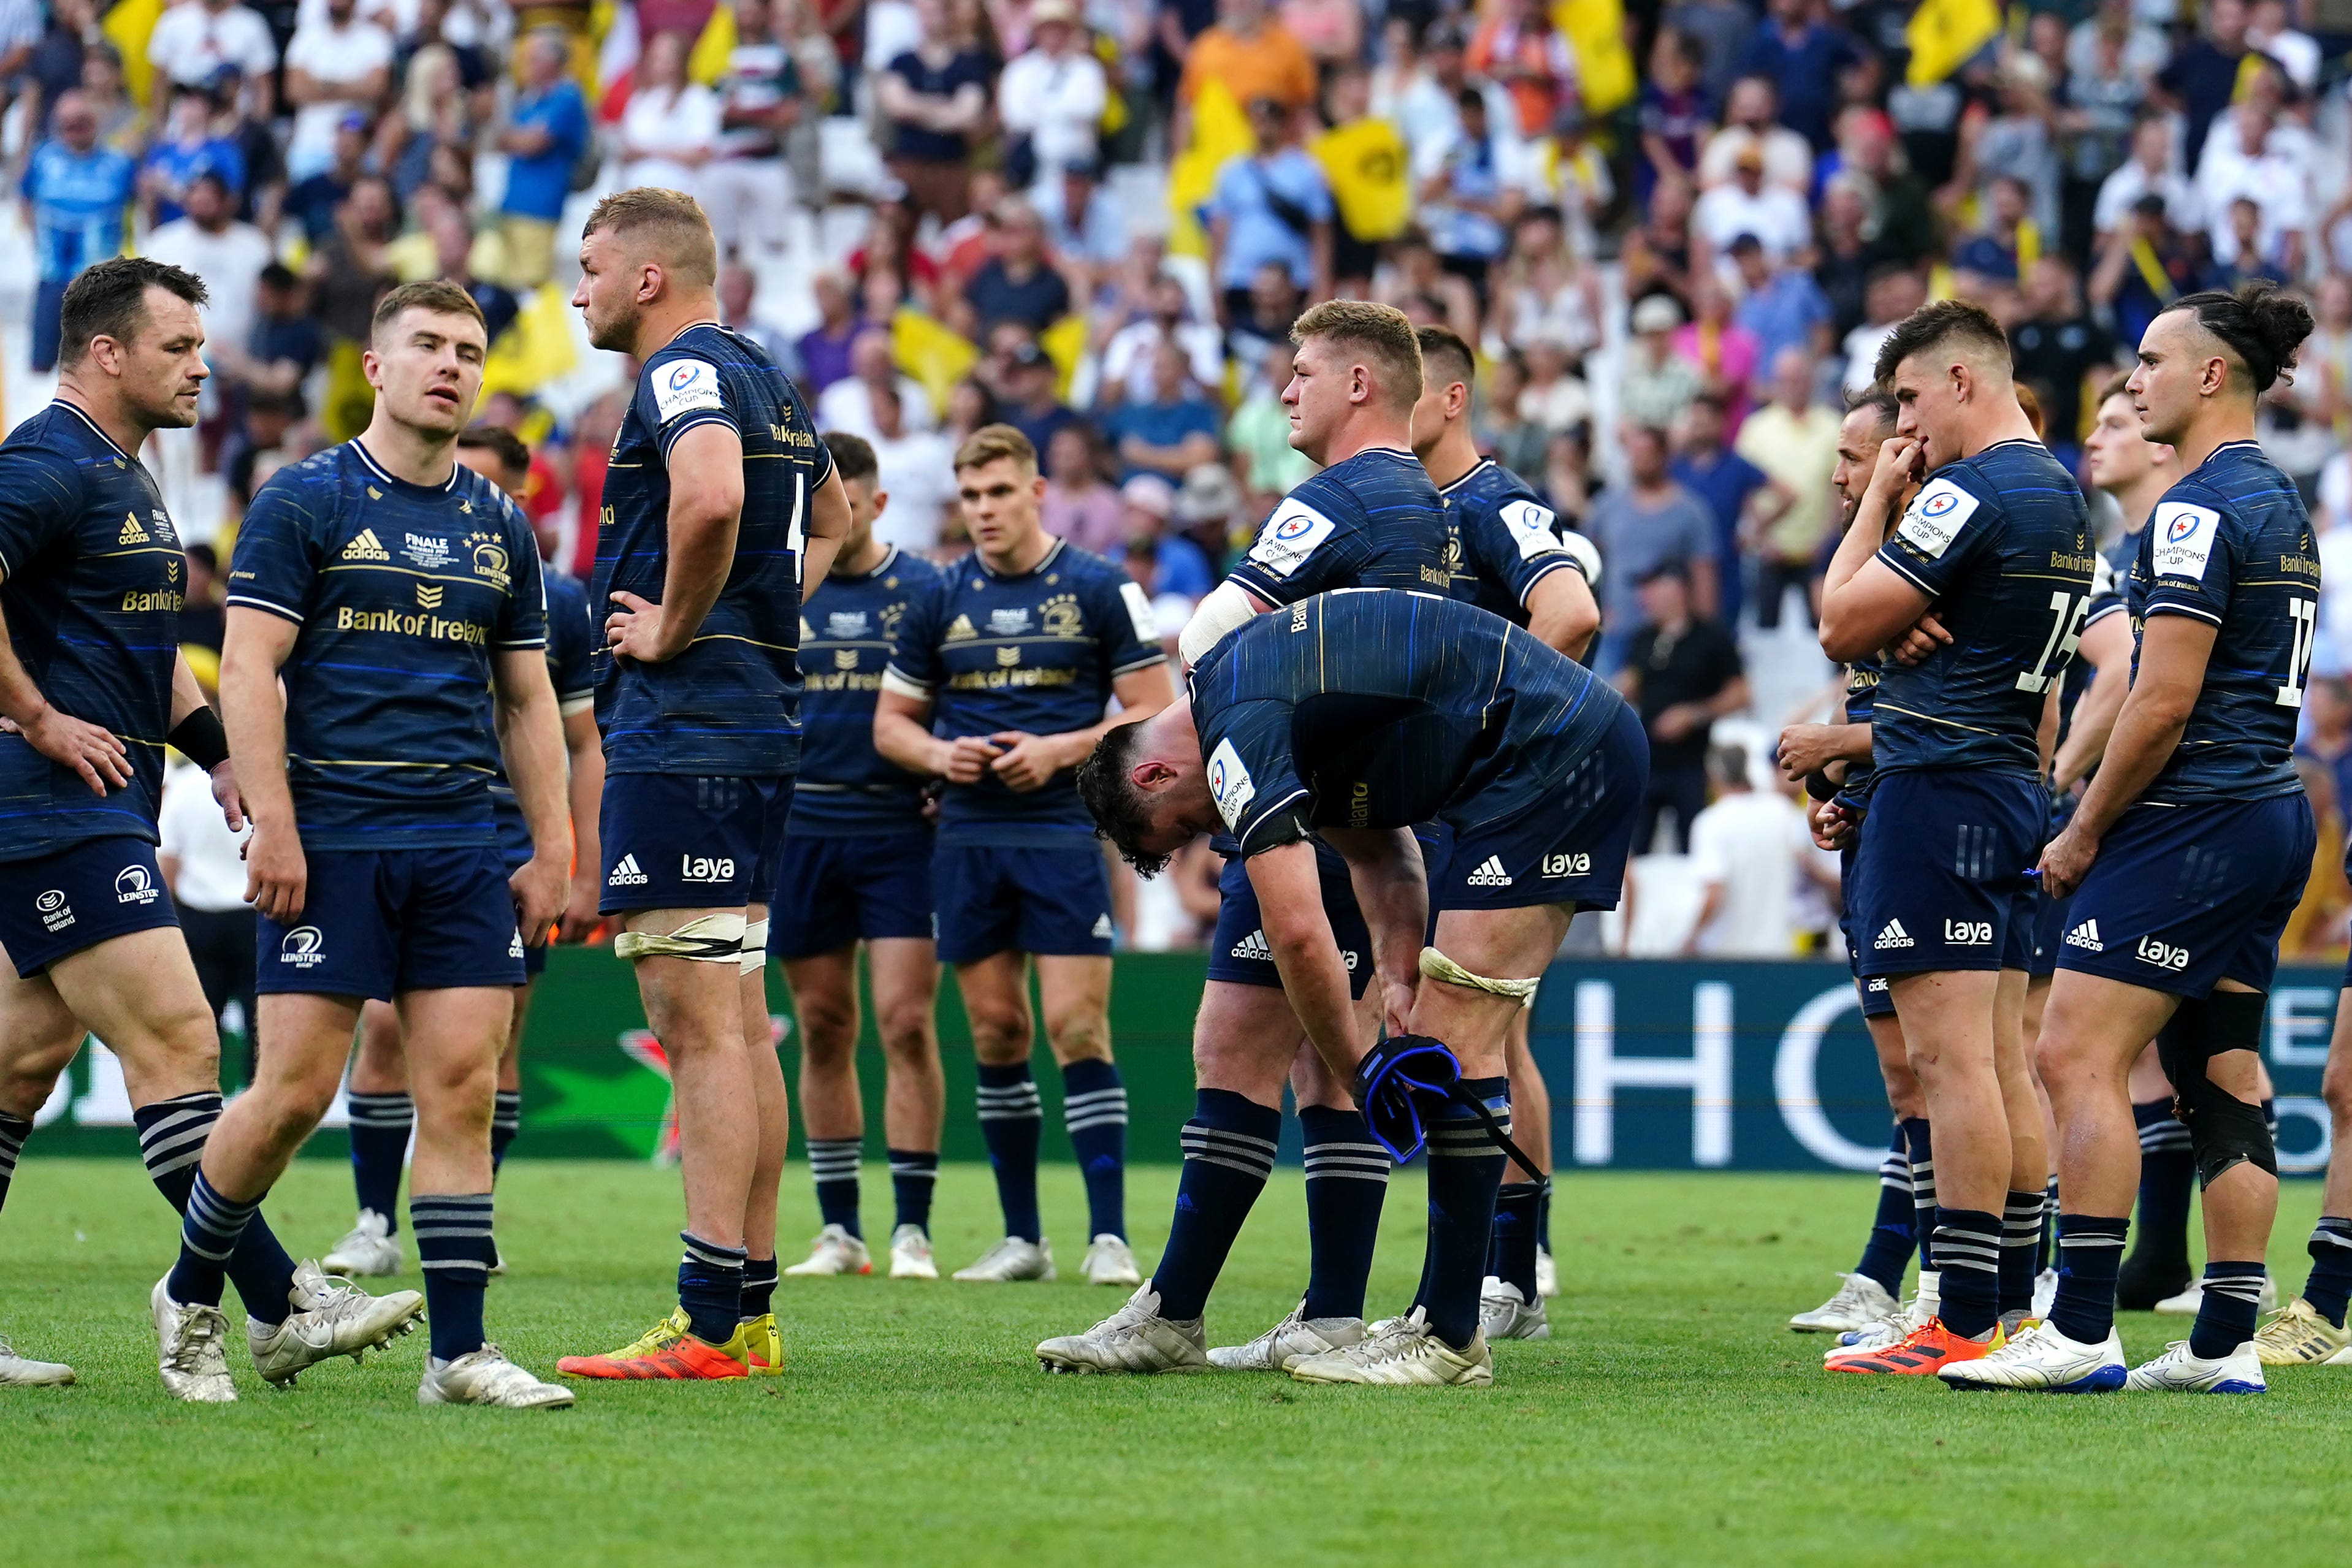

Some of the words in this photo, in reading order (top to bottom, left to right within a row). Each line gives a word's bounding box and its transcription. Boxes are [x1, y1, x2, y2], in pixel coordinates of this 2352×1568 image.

[660, 388, 718, 409] CHAMPIONS
[679, 395, 698, 406] CUP
[787, 473, 804, 584] 4
[1912, 525, 1930, 539] CUP
[119, 532, 150, 545] adidas
[405, 532, 449, 549] FINALE
[342, 548, 391, 561] adidas
[2050, 551, 2073, 571] Bank
[2073, 555, 2081, 571] of
[2155, 546, 2205, 562] CHAMPIONS
[2170, 556, 2183, 565] UP
[2303, 557, 2321, 579] Irelan
[2176, 580, 2199, 592] Ireland
[122, 589, 164, 612] Bank
[337, 607, 402, 633] Bank
[403, 614, 428, 636] of
[430, 616, 490, 645] Irelan
[683, 854, 735, 883] laya
[1542, 853, 1590, 877] laya
[609, 873, 648, 886] adidas
[1468, 874, 1512, 886] adidas
[118, 889, 158, 903] LEINSTER
[42, 910, 63, 924] Bank
[63, 905, 71, 915] of
[47, 915, 75, 932] Ireland
[1945, 919, 1992, 945] laya
[1874, 937, 1914, 950] adidas
[2066, 934, 2103, 951] adidas
[2138, 935, 2189, 967] laya
[281, 953, 323, 964] LEINSTER
[1231, 947, 1273, 961] adidas
